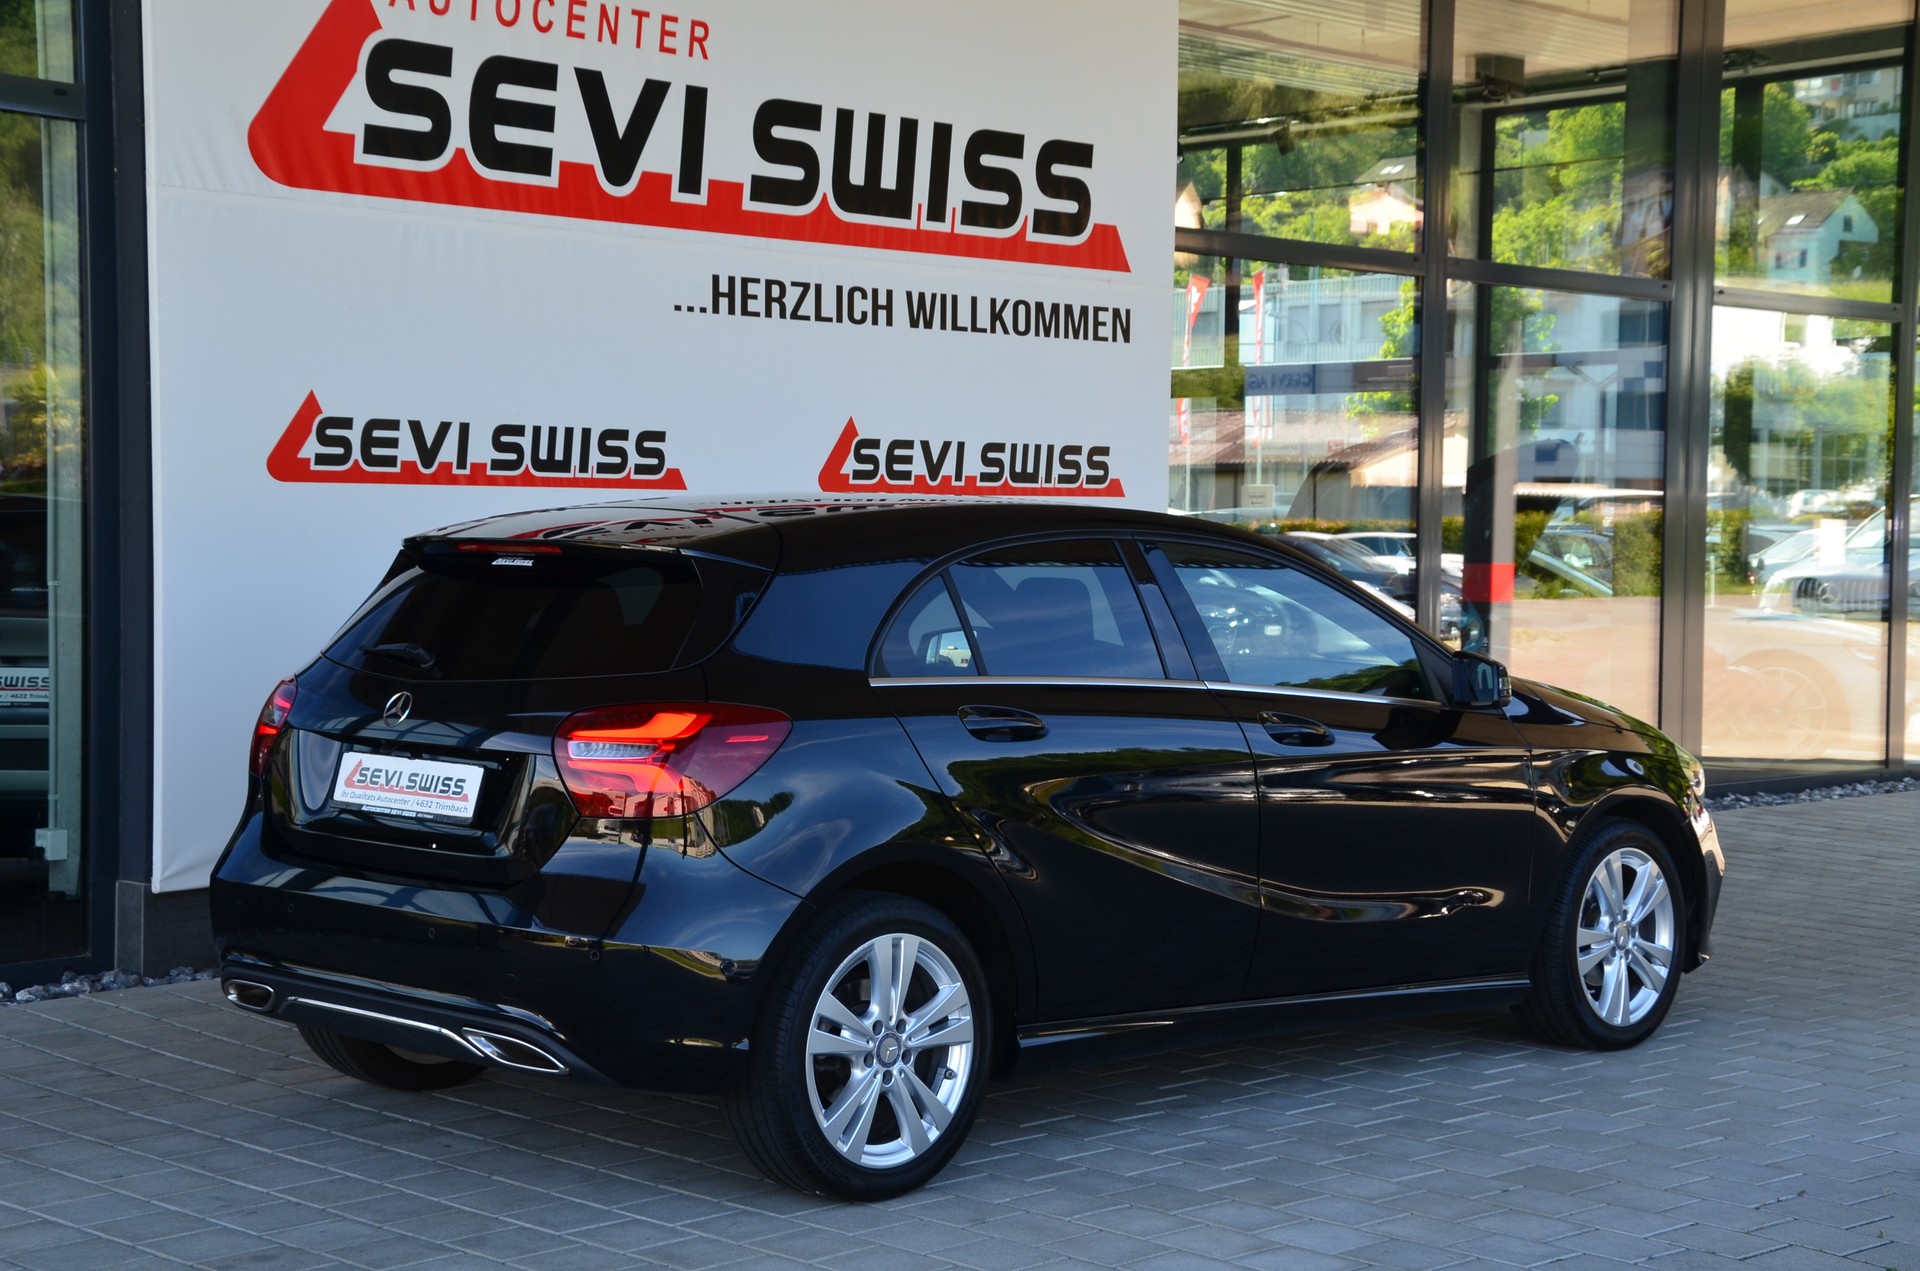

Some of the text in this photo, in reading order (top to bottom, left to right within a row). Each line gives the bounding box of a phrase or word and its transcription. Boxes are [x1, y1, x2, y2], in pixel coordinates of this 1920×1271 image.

[389, 0, 710, 60] OCENTER
[363, 38, 1094, 237] SEVI SWISS
[674, 274, 1131, 343] ...HERZLICH WILLKOMMEN
[314, 416, 667, 476] SEVI SWISS
[852, 438, 1110, 485] SEVI SWISS
[0, 676, 49, 688] WISS
[356, 766, 467, 796] SEVI SWISS
[377, 793, 410, 806] Autocenter
[415, 799, 433, 809] 4632
[435, 801, 469, 813] Trimbach
